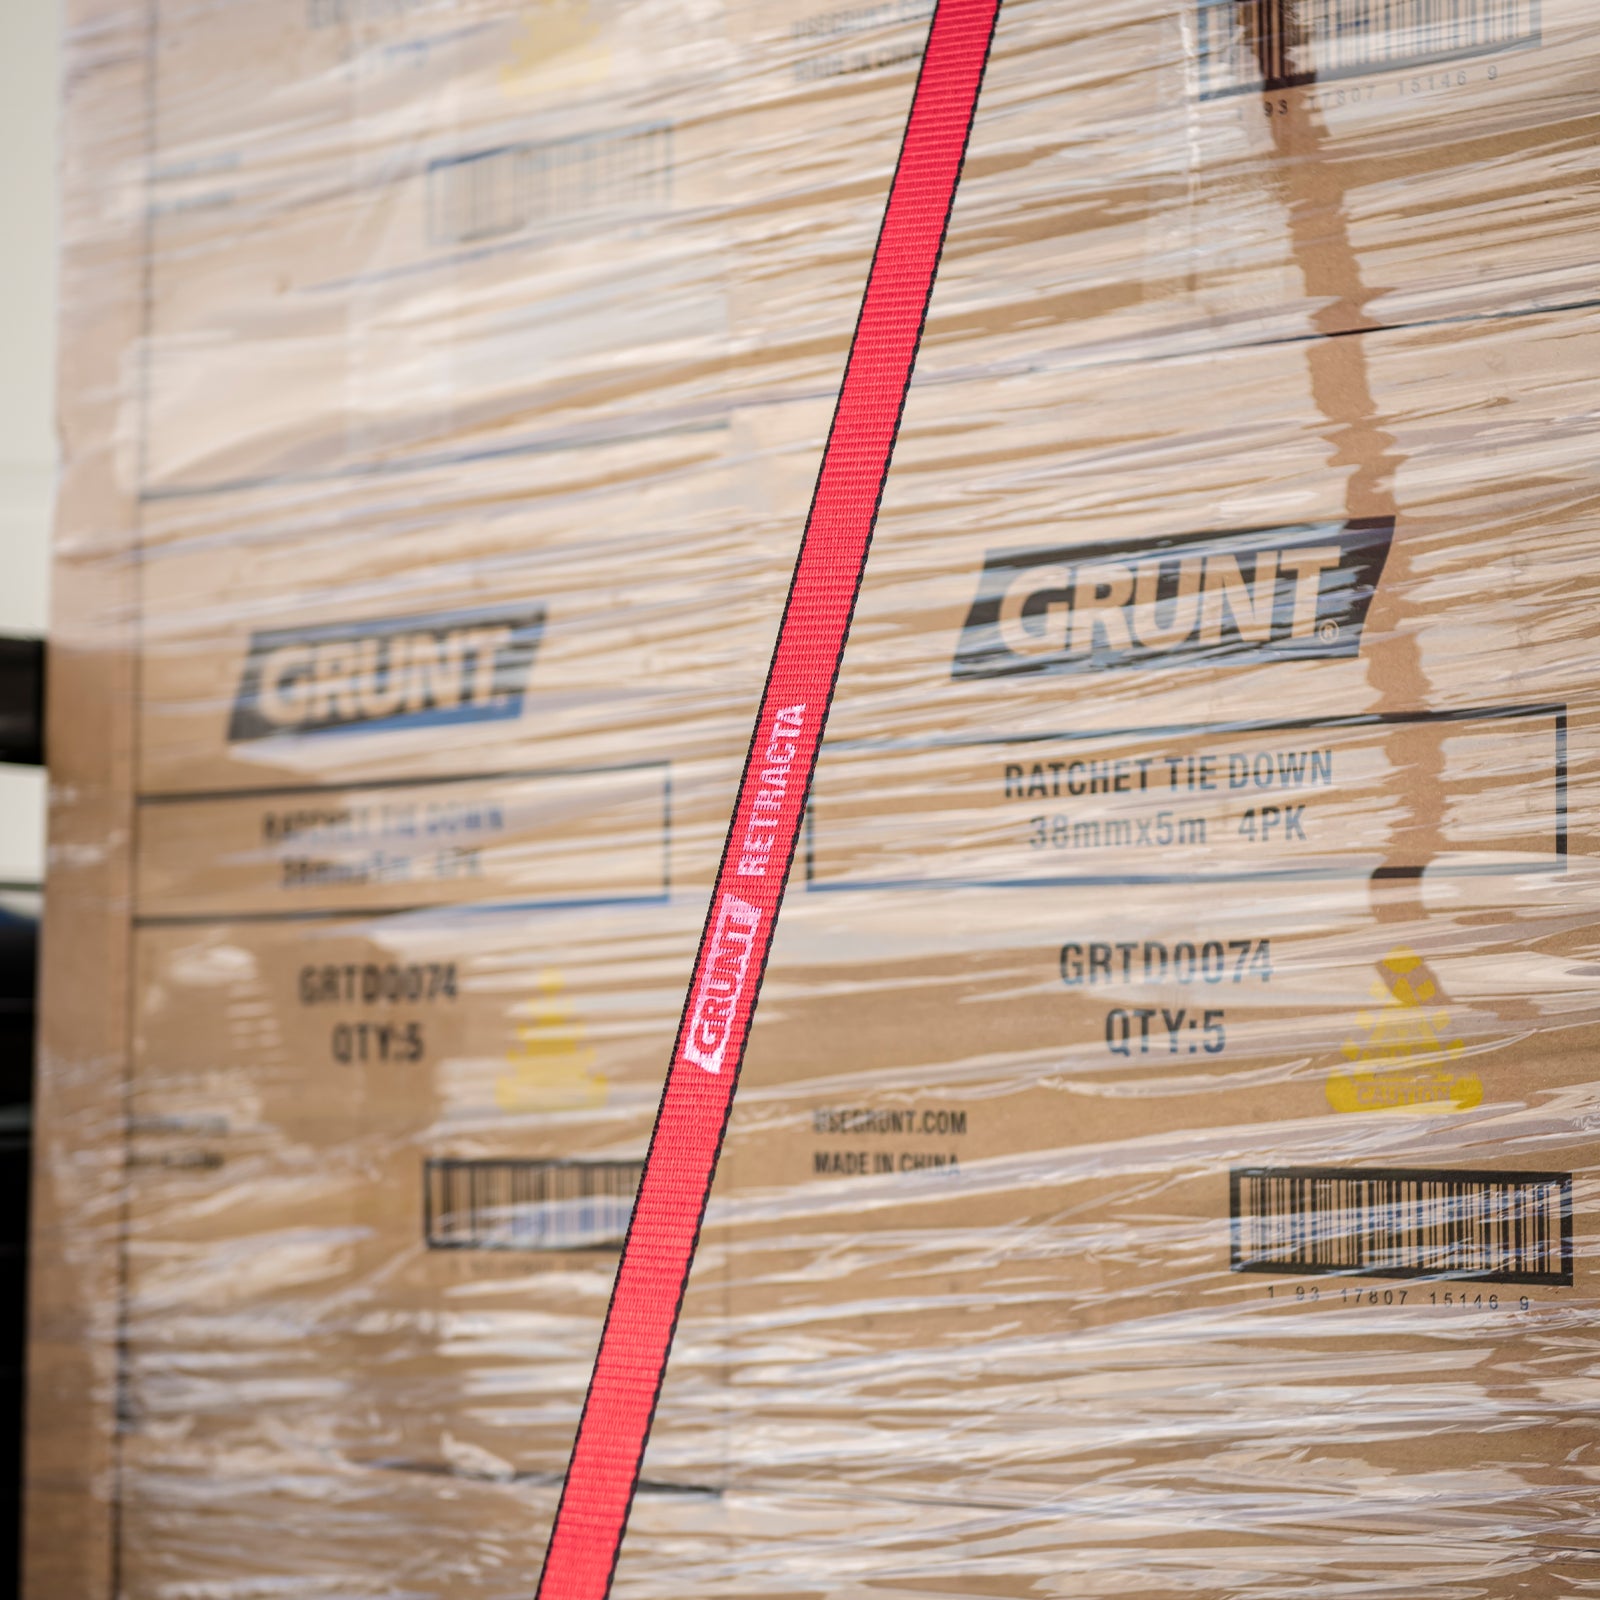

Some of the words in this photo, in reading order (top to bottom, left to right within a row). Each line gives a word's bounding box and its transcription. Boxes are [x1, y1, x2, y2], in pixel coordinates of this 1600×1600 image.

[1000, 545, 1341, 656] GRUNT
[257, 626, 516, 729] GRUNT
[737, 703, 806, 876] RETRACTA
[1005, 757, 1154, 798] RATCHET
[1165, 754, 1218, 794] TIE
[1229, 749, 1333, 790] DOWN
[1028, 810, 1208, 851] 38mmx5m
[1238, 804, 1308, 843] 4PK
[689, 906, 758, 1062] GRUNT
[1060, 938, 1274, 987] GRTD0074
[333, 1022, 425, 1064] QTY:5
[1106, 1008, 1226, 1057] QTY:5
[814, 1153, 868, 1175] MADE
[873, 1153, 894, 1174] IN
[901, 1153, 960, 1176] CHINA
[1267, 1285, 1275, 1299] 1
[1296, 1285, 1321, 1301] 93
[1340, 1288, 1408, 1305] 17807
[1429, 1291, 1499, 1309] 15146
[1519, 1295, 1529, 1310] 9
